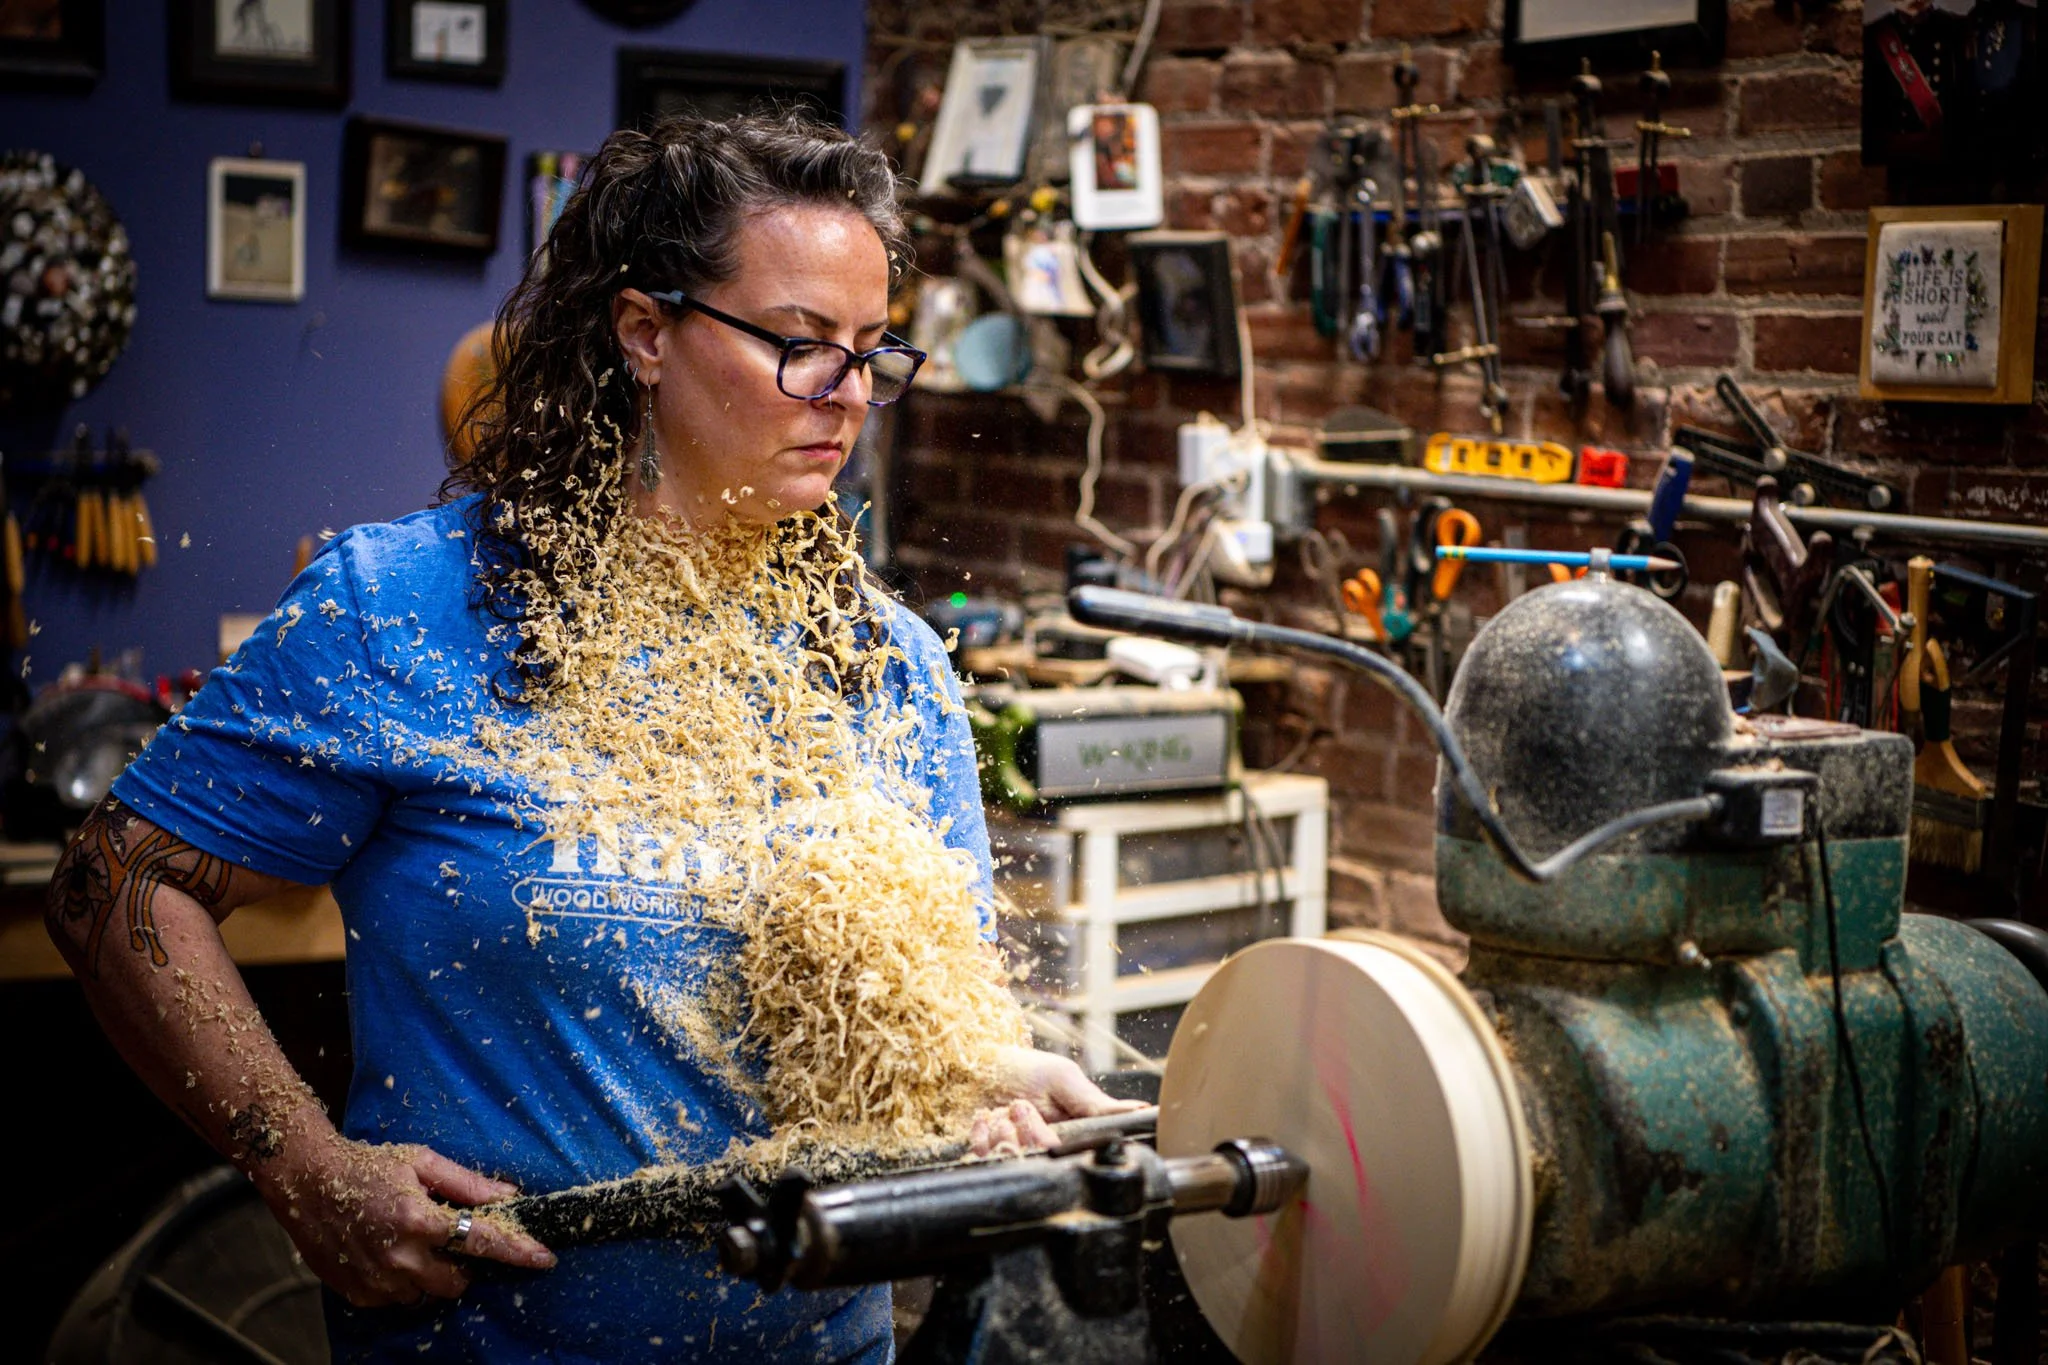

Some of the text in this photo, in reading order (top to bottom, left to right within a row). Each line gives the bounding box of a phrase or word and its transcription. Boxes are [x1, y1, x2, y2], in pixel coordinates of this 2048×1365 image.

[1906, 268, 1964, 288] LIFE IS
[1904, 286, 1962, 305] SHORT
[1902, 330, 1962, 346] YOUR CAT
